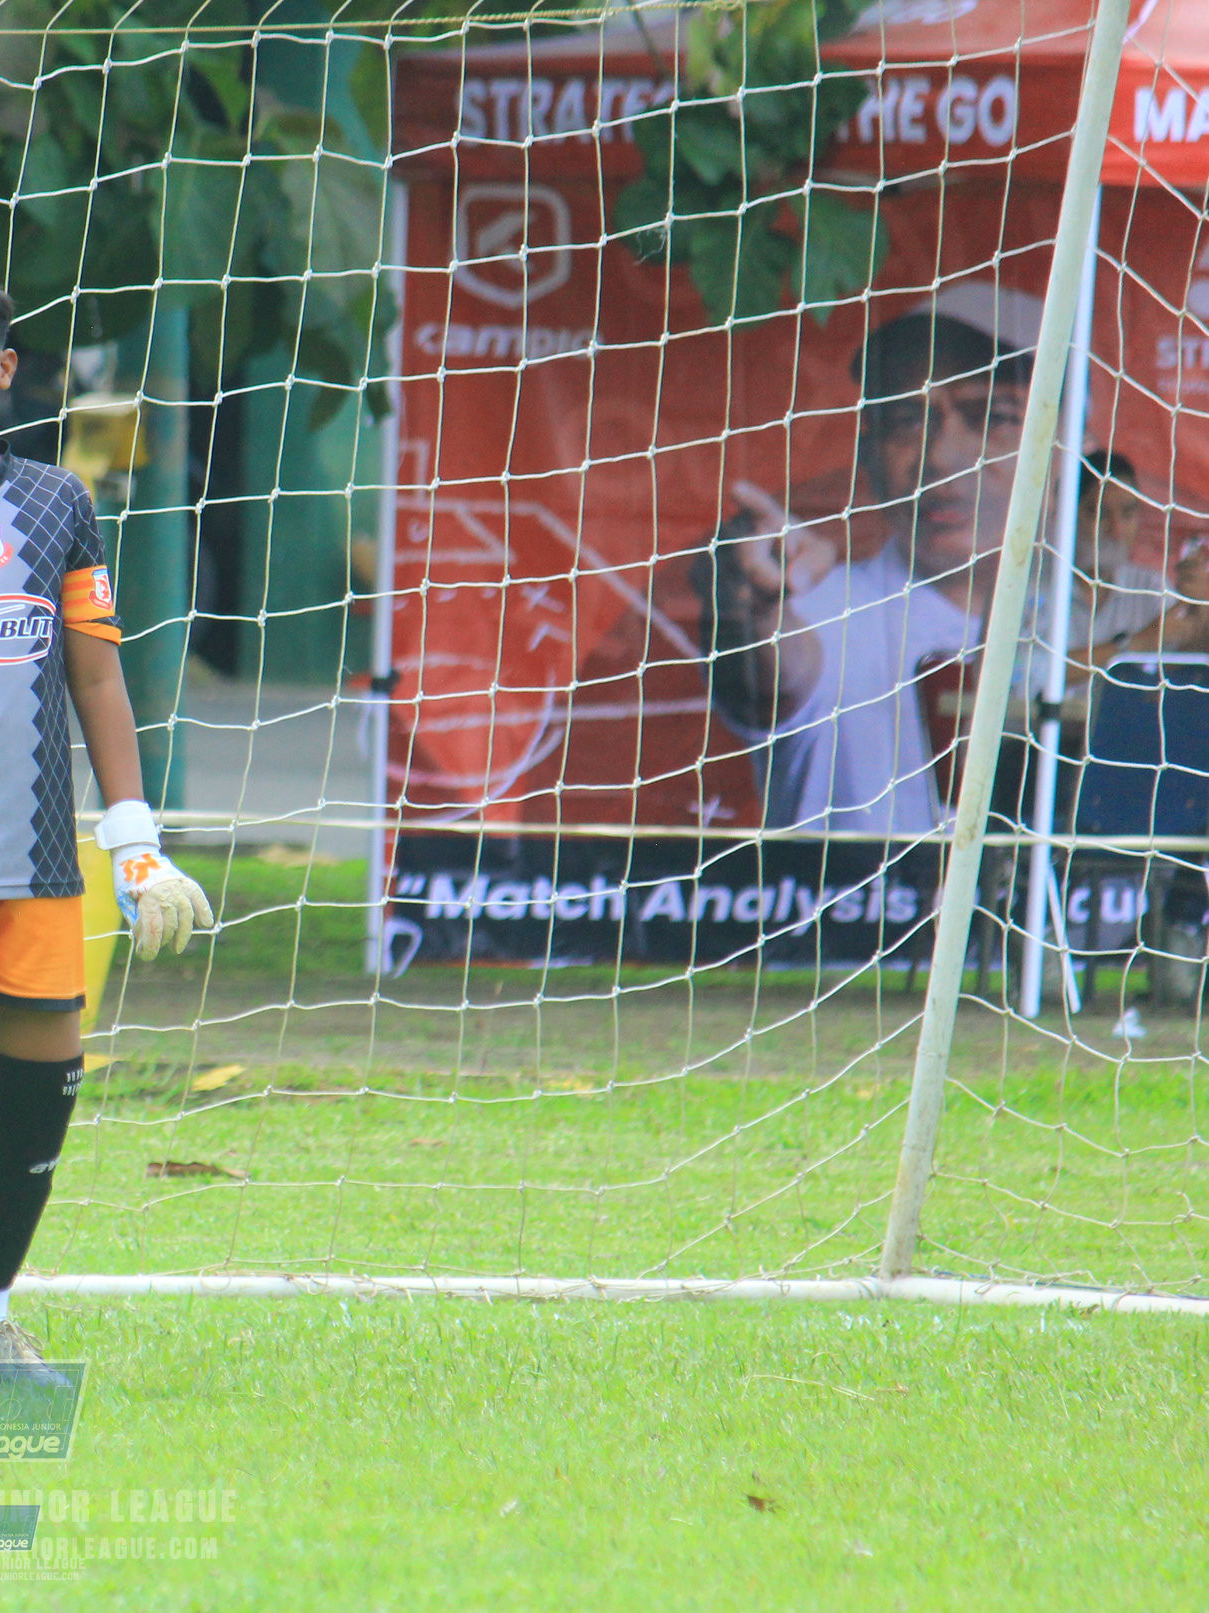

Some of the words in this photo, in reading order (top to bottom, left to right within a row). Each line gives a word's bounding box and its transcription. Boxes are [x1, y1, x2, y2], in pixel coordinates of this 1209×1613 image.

[455, 77, 678, 147] STRATE
[837, 76, 932, 145] HE
[936, 75, 1019, 147] GO
[640, 876, 918, 937] Analysis
